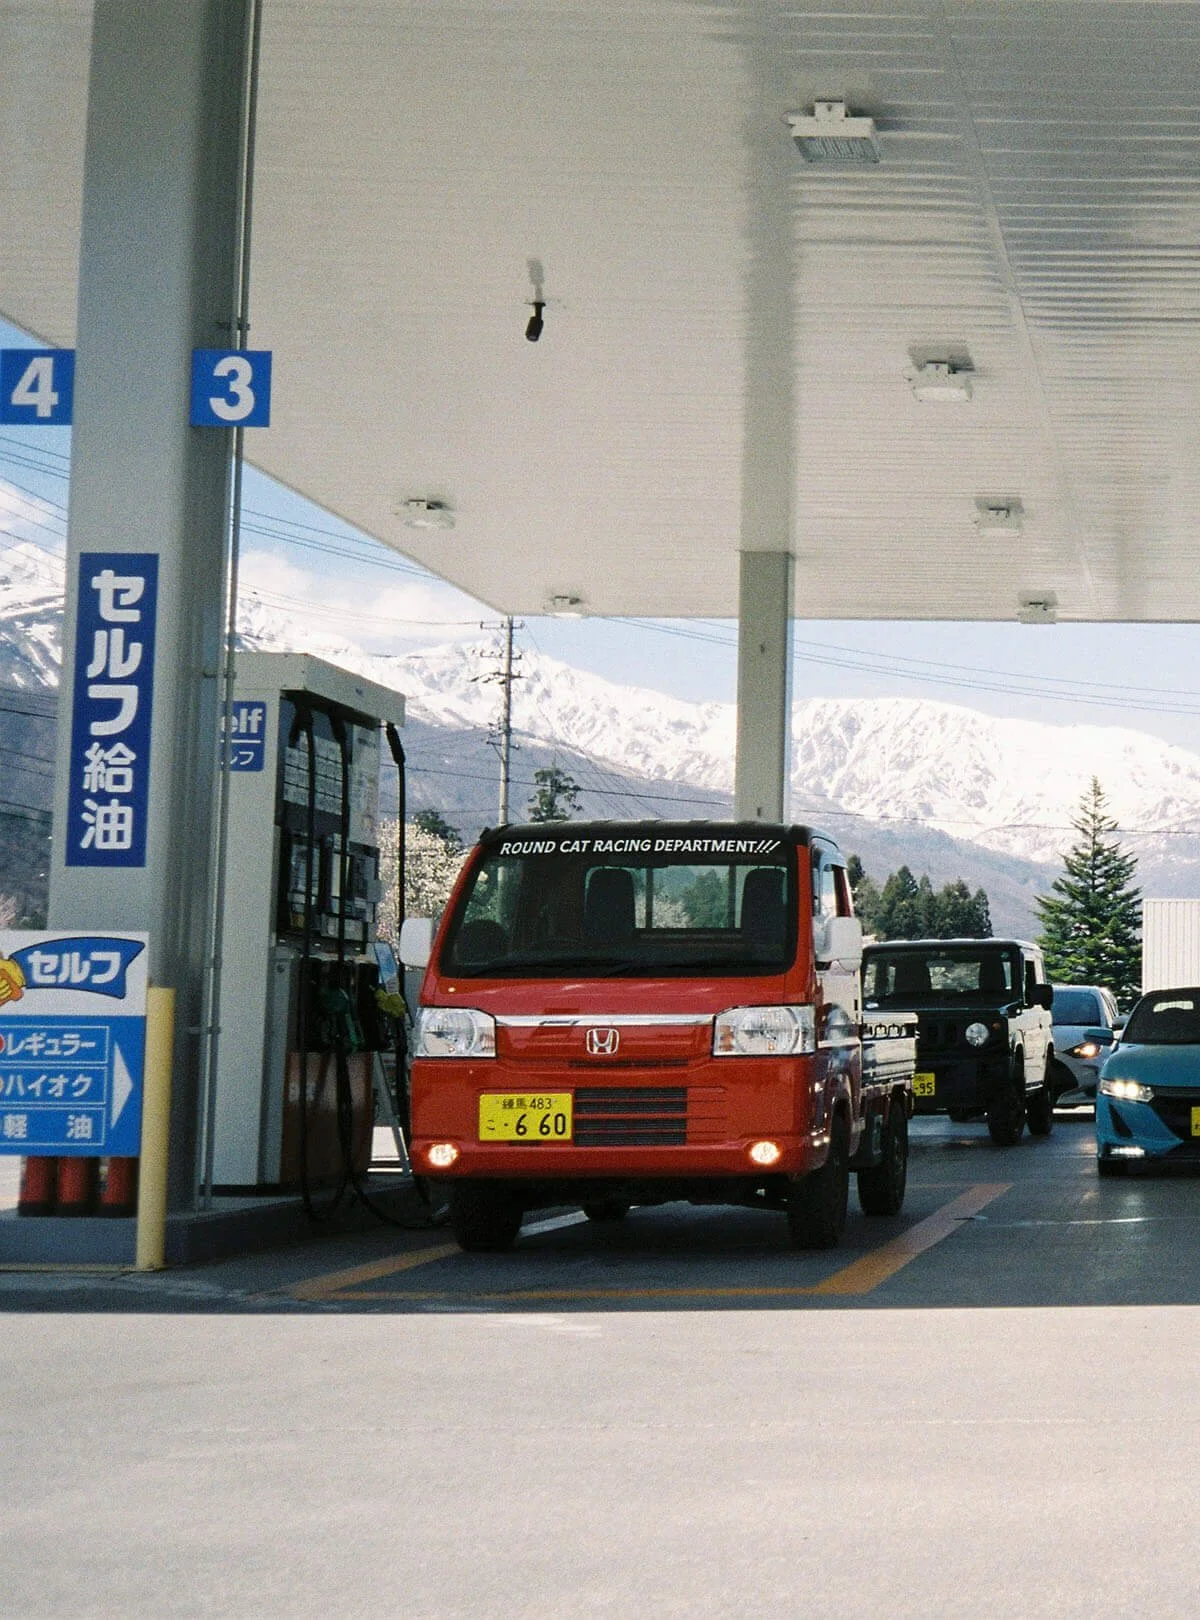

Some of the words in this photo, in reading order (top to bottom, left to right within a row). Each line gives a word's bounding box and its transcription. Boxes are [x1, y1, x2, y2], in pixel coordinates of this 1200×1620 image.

[11, 357, 59, 418] 4
[209, 356, 256, 421] 3
[80, 569, 145, 850] セルフ給油
[500, 841, 556, 855] ROUND
[559, 840, 591, 854] CAT
[593, 839, 652, 853] RACING
[653, 839, 781, 854] DEPARTMENT!!!
[28, 951, 121, 984] セルフ
[7, 1033, 96, 1056] レギュラー
[5, 1074, 93, 1097] ハイオク
